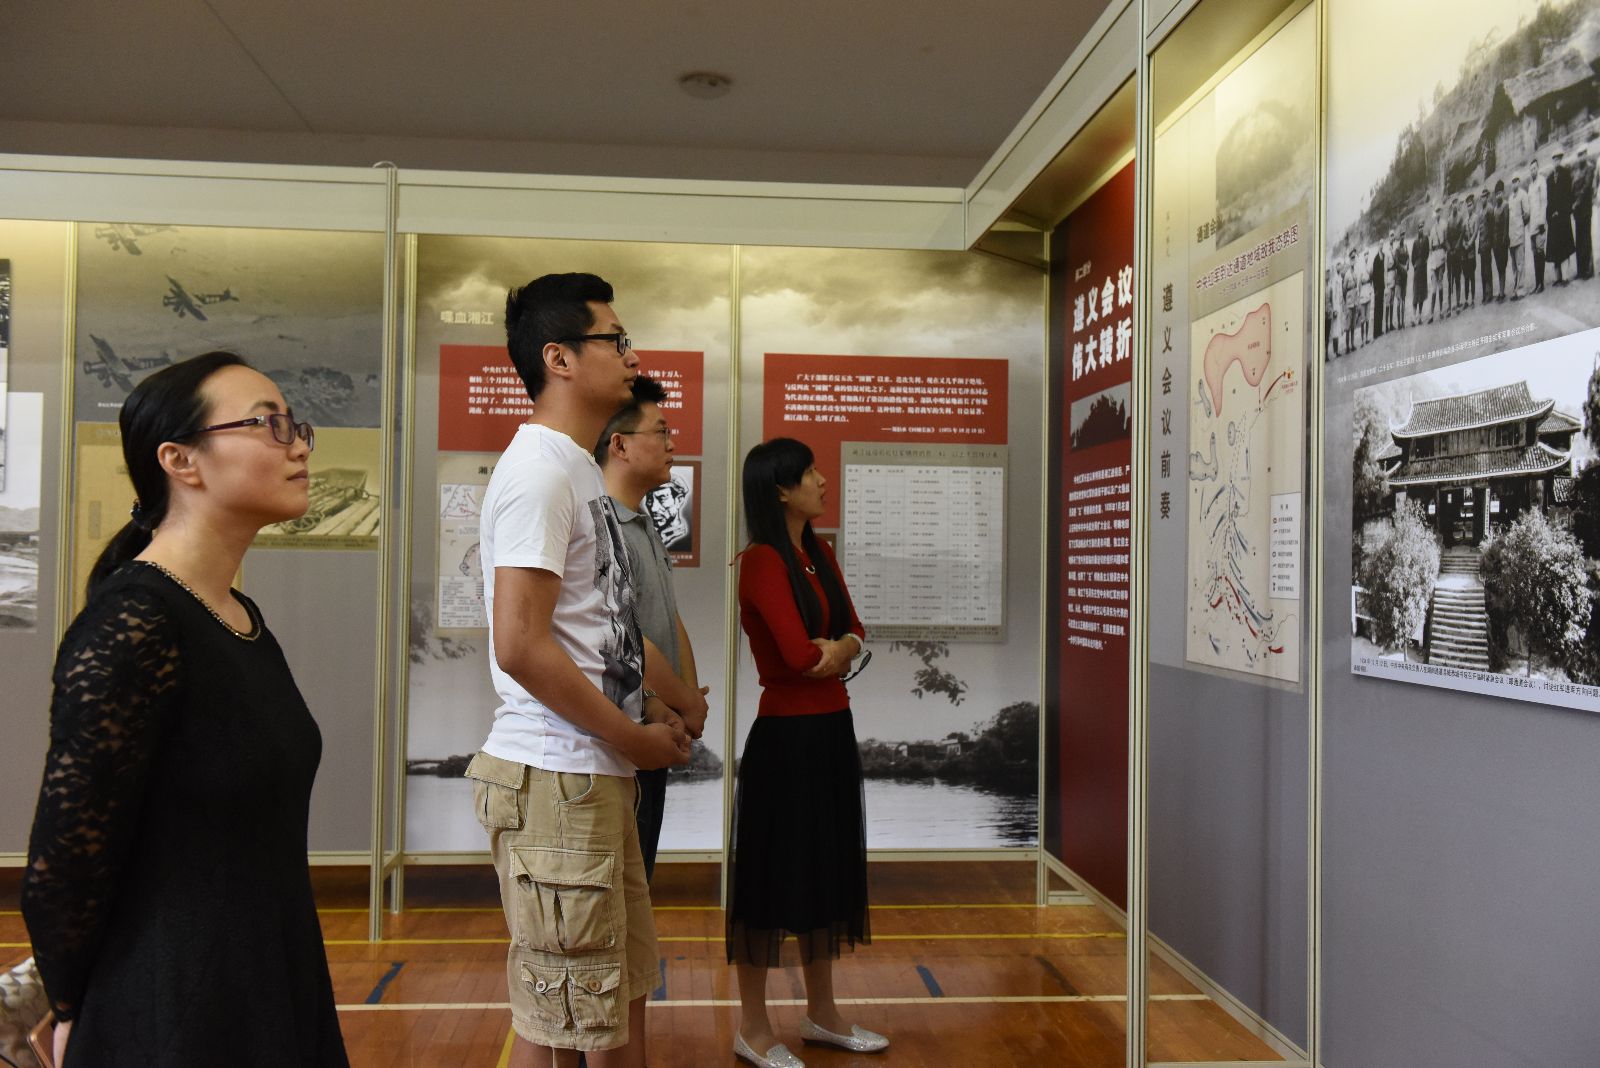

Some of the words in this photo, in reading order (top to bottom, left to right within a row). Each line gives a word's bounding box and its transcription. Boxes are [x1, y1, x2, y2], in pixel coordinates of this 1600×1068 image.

[440, 310, 494, 325] 喋血湘江
[1072, 264, 1133, 333] 遵义会议
[1072, 317, 1132, 381] 伟大转折
[1159, 282, 1174, 520] 遵义会议前奏
